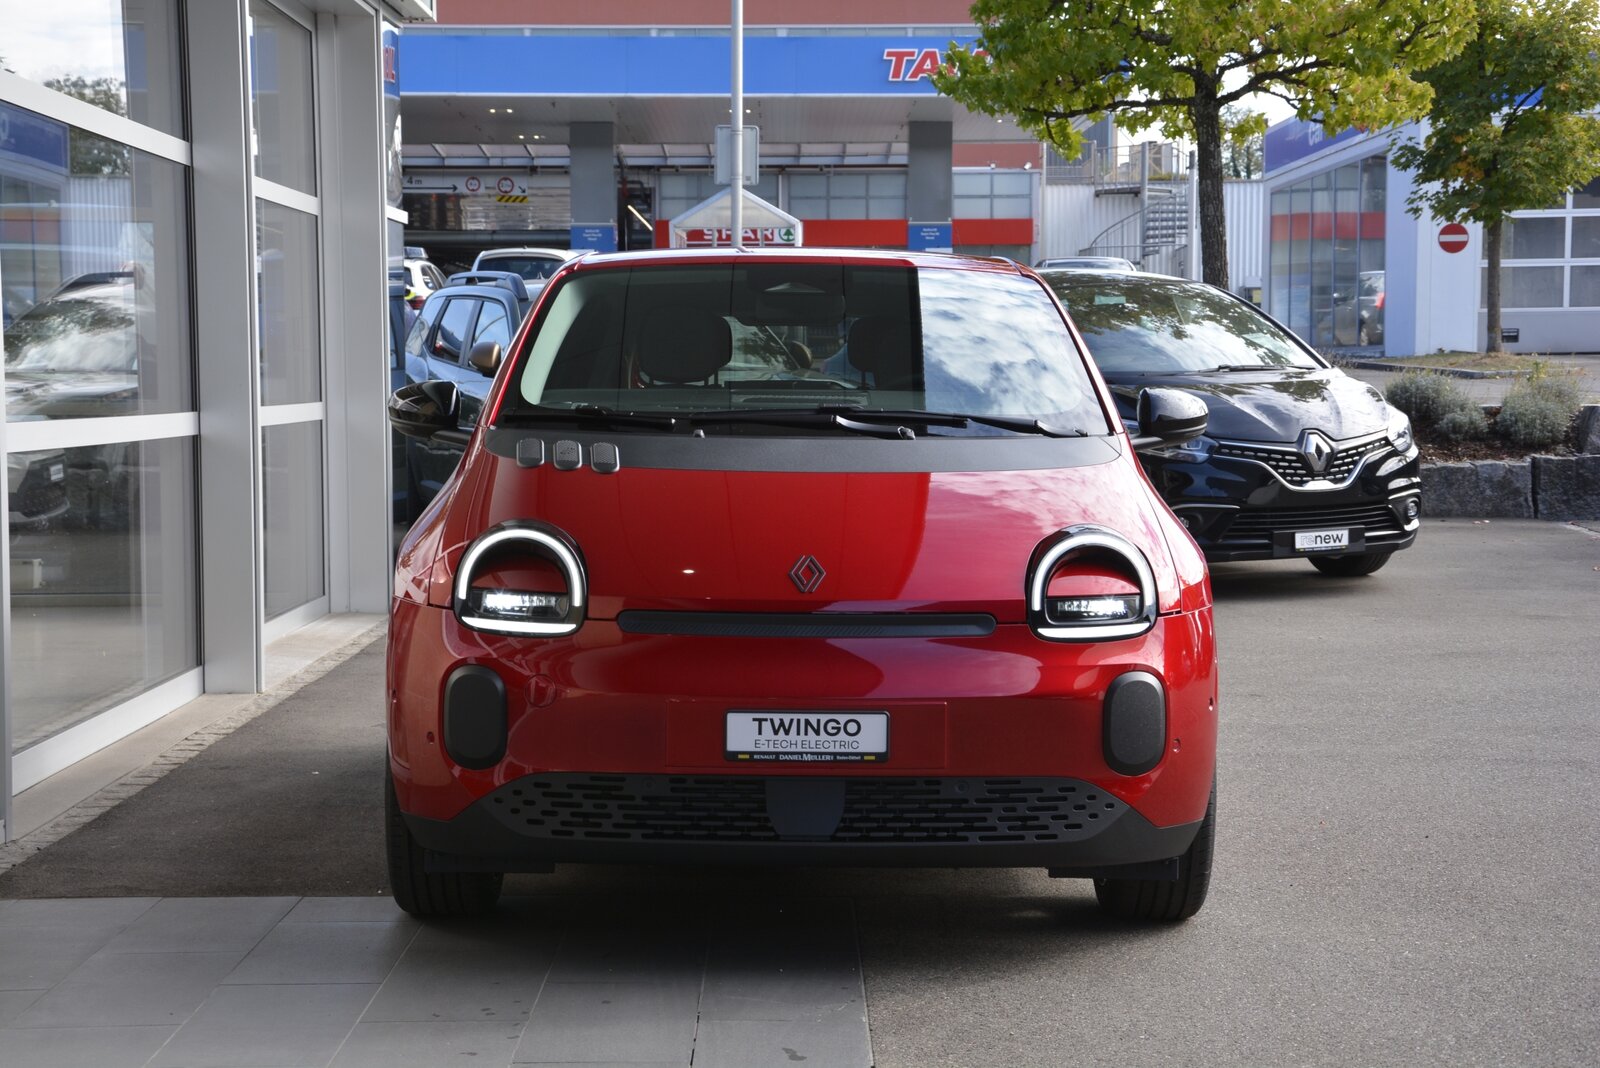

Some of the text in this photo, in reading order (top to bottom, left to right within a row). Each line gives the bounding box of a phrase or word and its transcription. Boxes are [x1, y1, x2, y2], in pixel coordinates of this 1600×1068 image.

[1300, 533, 1344, 546] renew
[752, 717, 862, 737] TWINGO
[754, 739, 860, 750] E-TECH ELECTRIC
